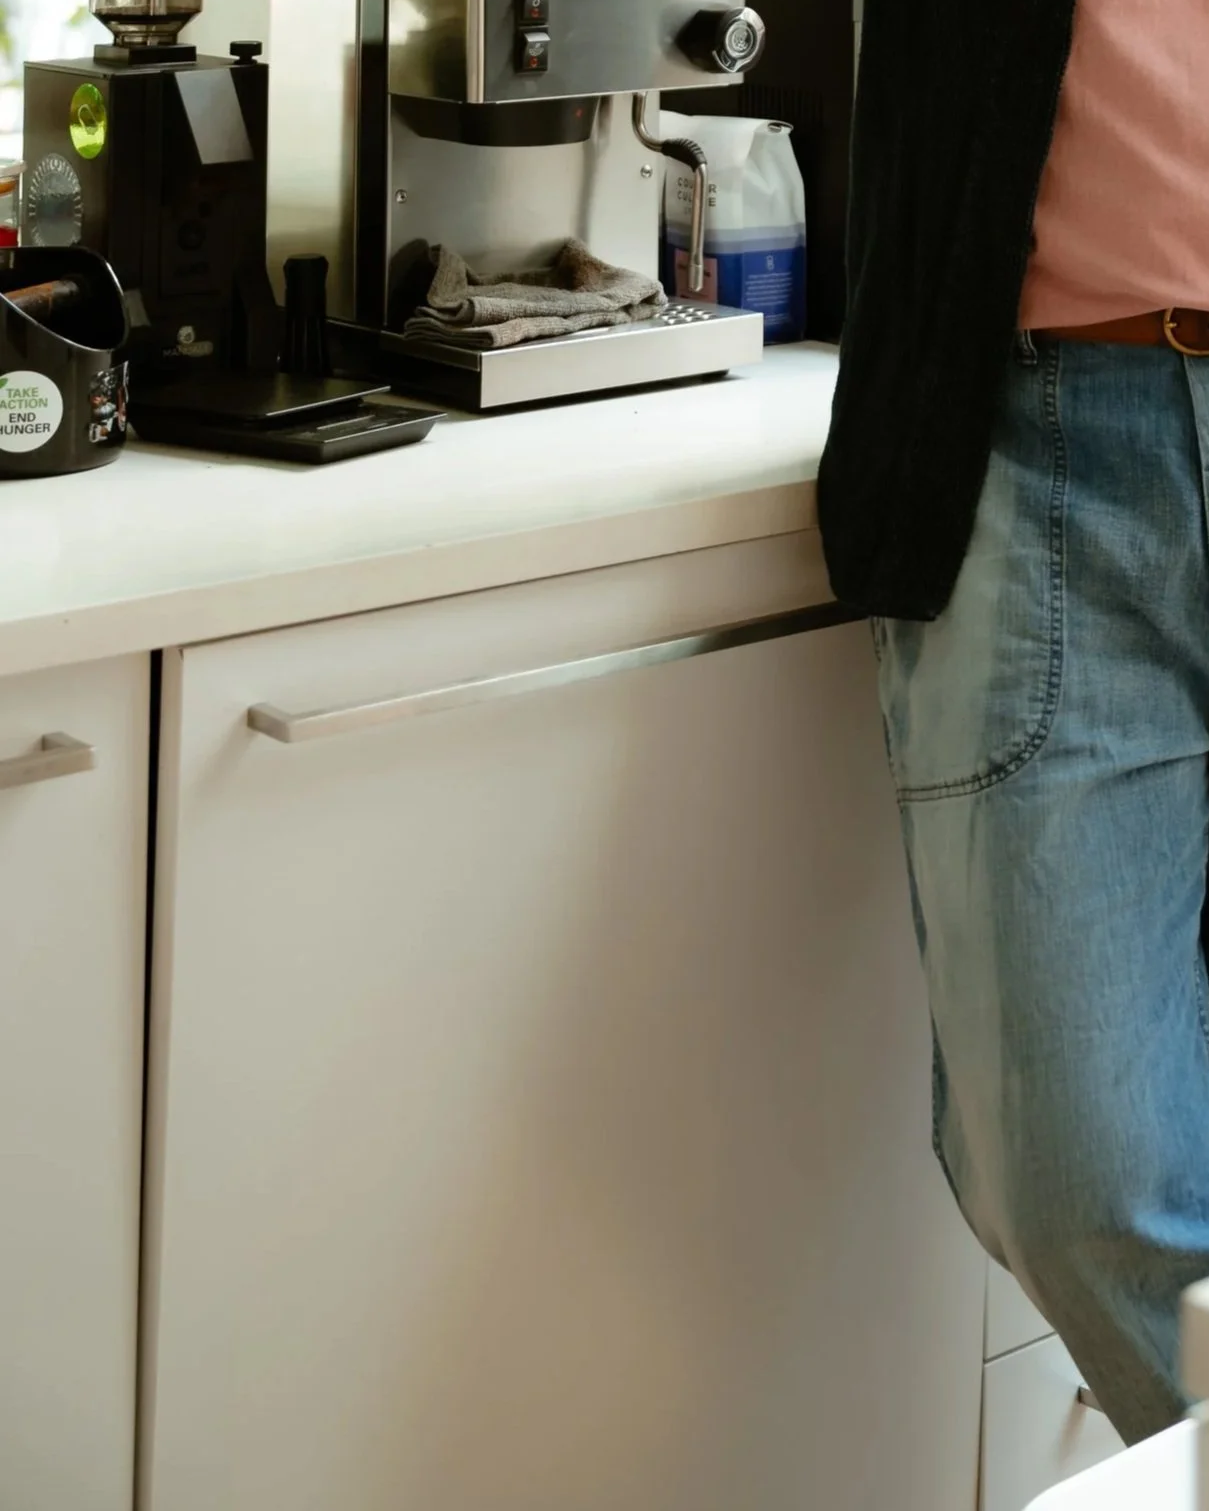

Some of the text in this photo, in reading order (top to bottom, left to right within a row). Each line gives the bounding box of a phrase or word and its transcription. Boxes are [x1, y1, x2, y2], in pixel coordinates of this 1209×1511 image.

[6, 387, 39, 398] TAKE
[0, 398, 48, 409] ACTION
[9, 412, 37, 423] END
